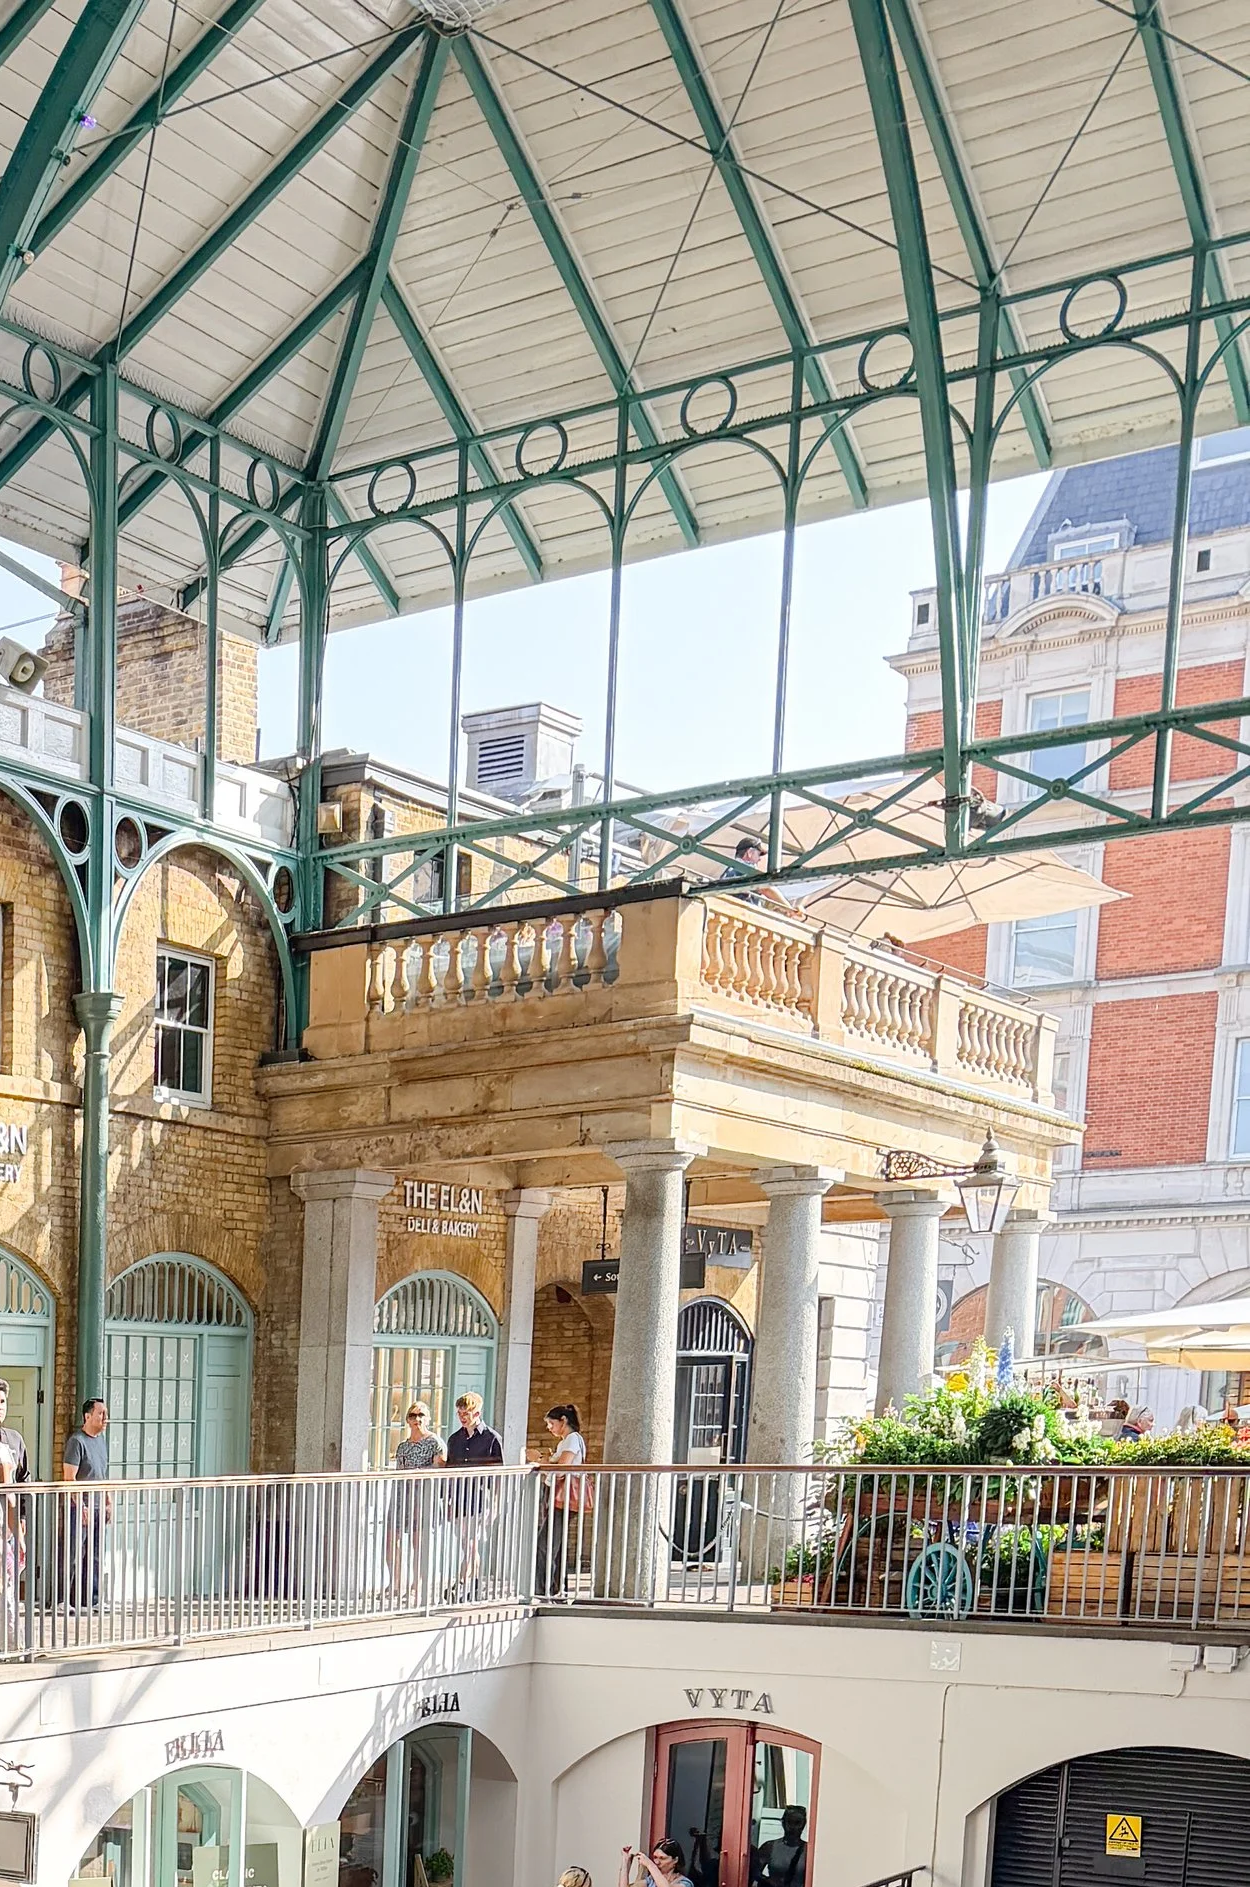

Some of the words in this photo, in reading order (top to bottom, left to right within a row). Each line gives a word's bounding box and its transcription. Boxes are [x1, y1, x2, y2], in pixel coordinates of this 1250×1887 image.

[403, 1181, 437, 1210] THE
[440, 1184, 483, 1215] EL&N
[407, 1216, 431, 1233] DELI
[432, 1219, 439, 1234] &
[441, 1220, 479, 1238] BAKERY
[683, 1688, 775, 1714] VYTA
